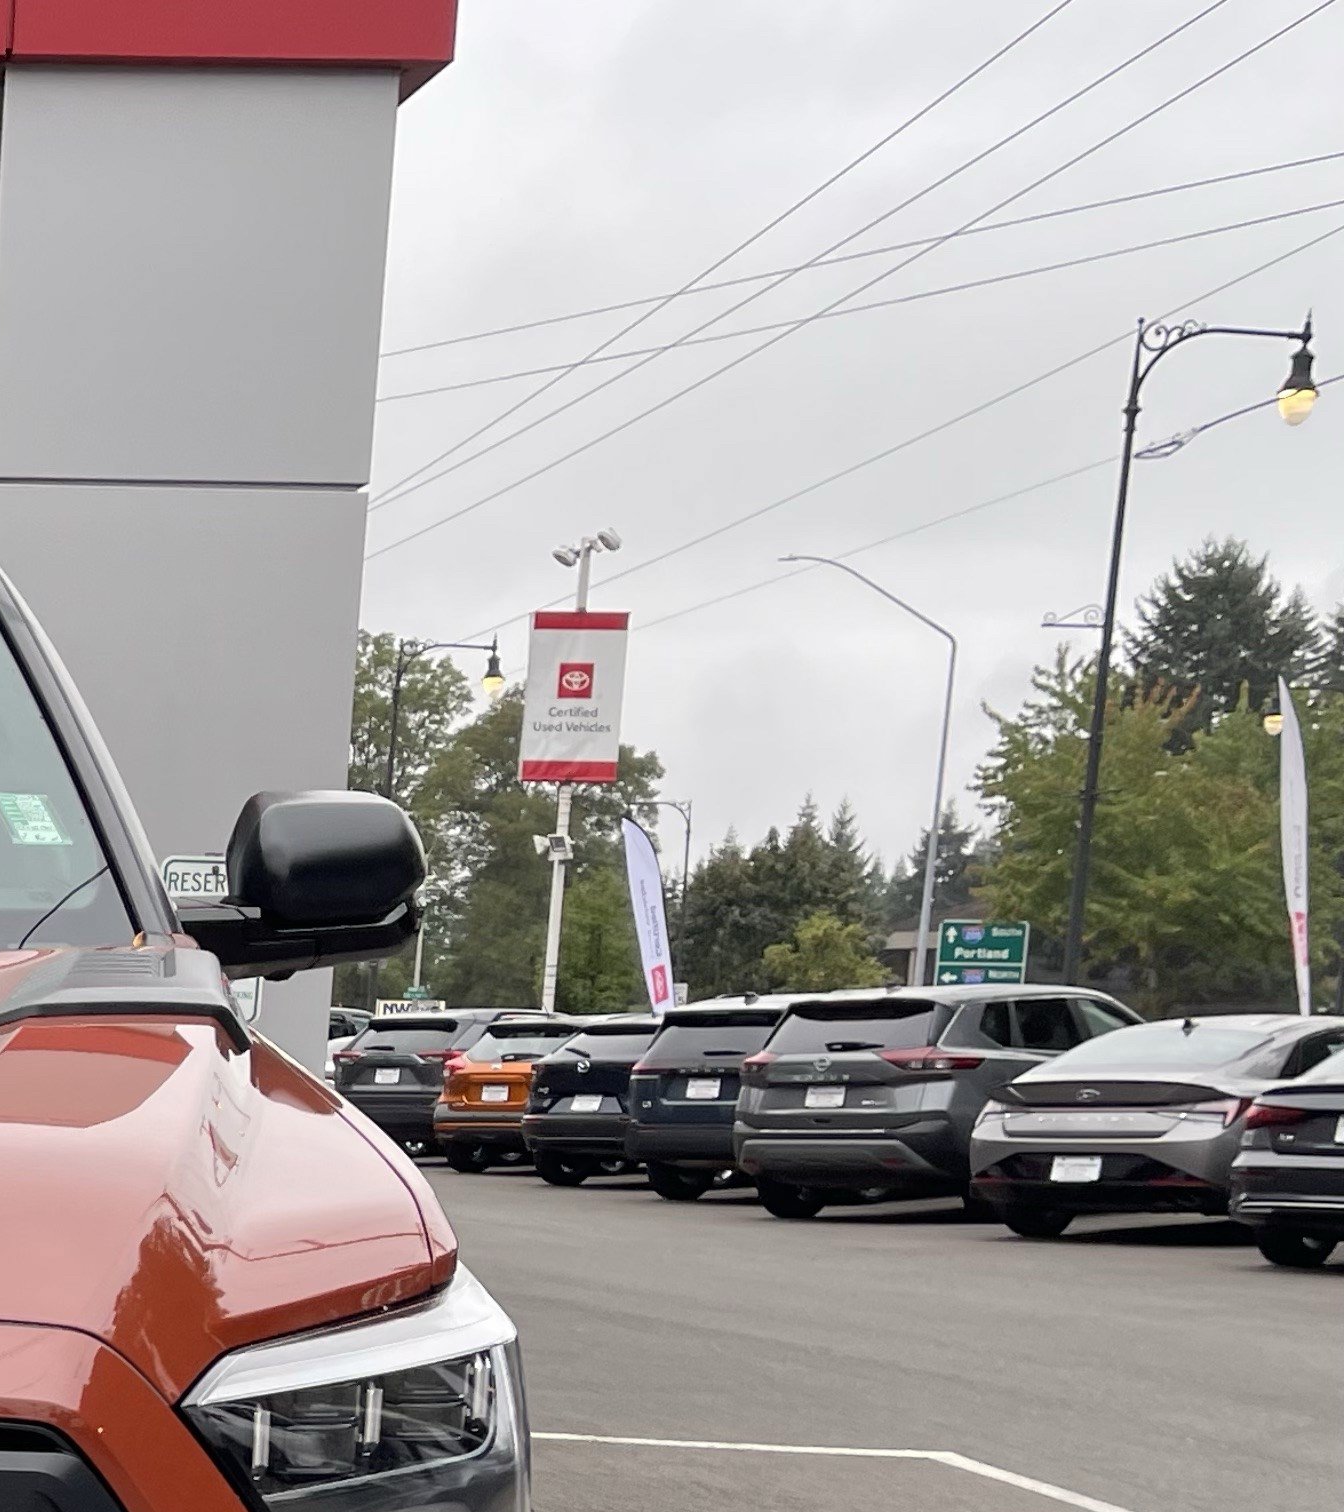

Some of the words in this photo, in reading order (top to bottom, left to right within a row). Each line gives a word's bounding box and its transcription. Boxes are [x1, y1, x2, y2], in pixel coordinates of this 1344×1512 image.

[548, 706, 598, 718] Certified
[533, 722, 562, 732] Used
[566, 722, 612, 732] Vehicles
[953, 946, 1010, 960] Portland
